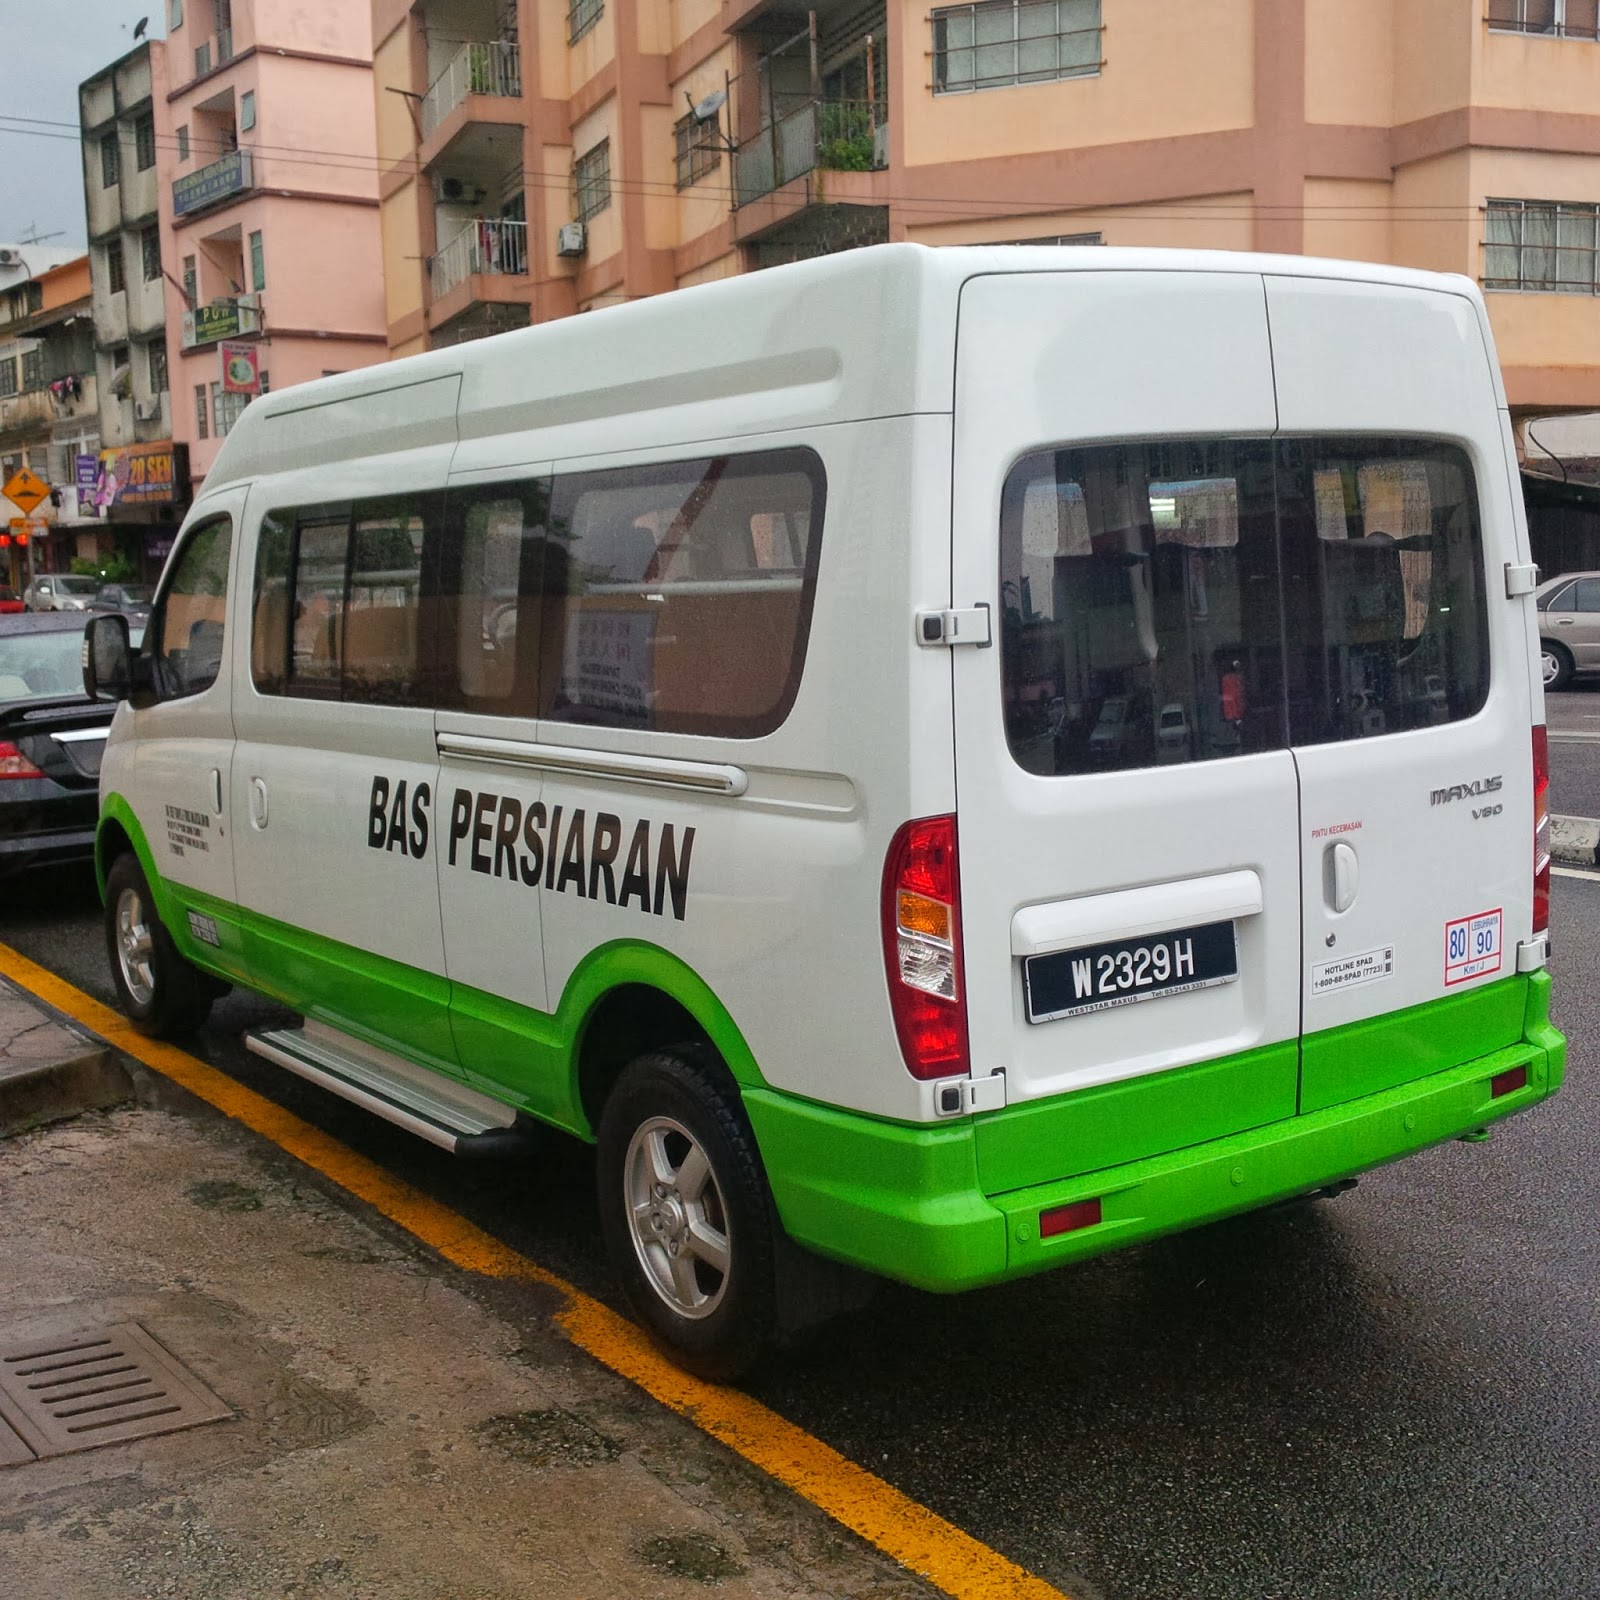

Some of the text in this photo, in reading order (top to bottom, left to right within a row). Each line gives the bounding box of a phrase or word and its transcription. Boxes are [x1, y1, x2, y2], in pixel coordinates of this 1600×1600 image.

[129, 455, 172, 485] 20 SEN
[1430, 775, 1503, 806] MAXUS
[1472, 804, 1503, 820] V80
[1311, 820, 1363, 839] PINTU KECEMASAN
[368, 775, 696, 921] BAS PERSIARAN
[1471, 916, 1499, 931] LEBUHRAYA
[1449, 927, 1466, 959] 80
[1476, 929, 1493, 955] 90
[1314, 964, 1383, 988] 1-800-88-SPAD (7723)
[1324, 956, 1373, 975] HOTLINE SPAD
[1067, 1001, 1109, 1016] WESTSTAR
[1111, 995, 1138, 1007] MAXUS
[1151, 990, 1164, 998] Tel:
[1164, 984, 1190, 995] 03-2143
